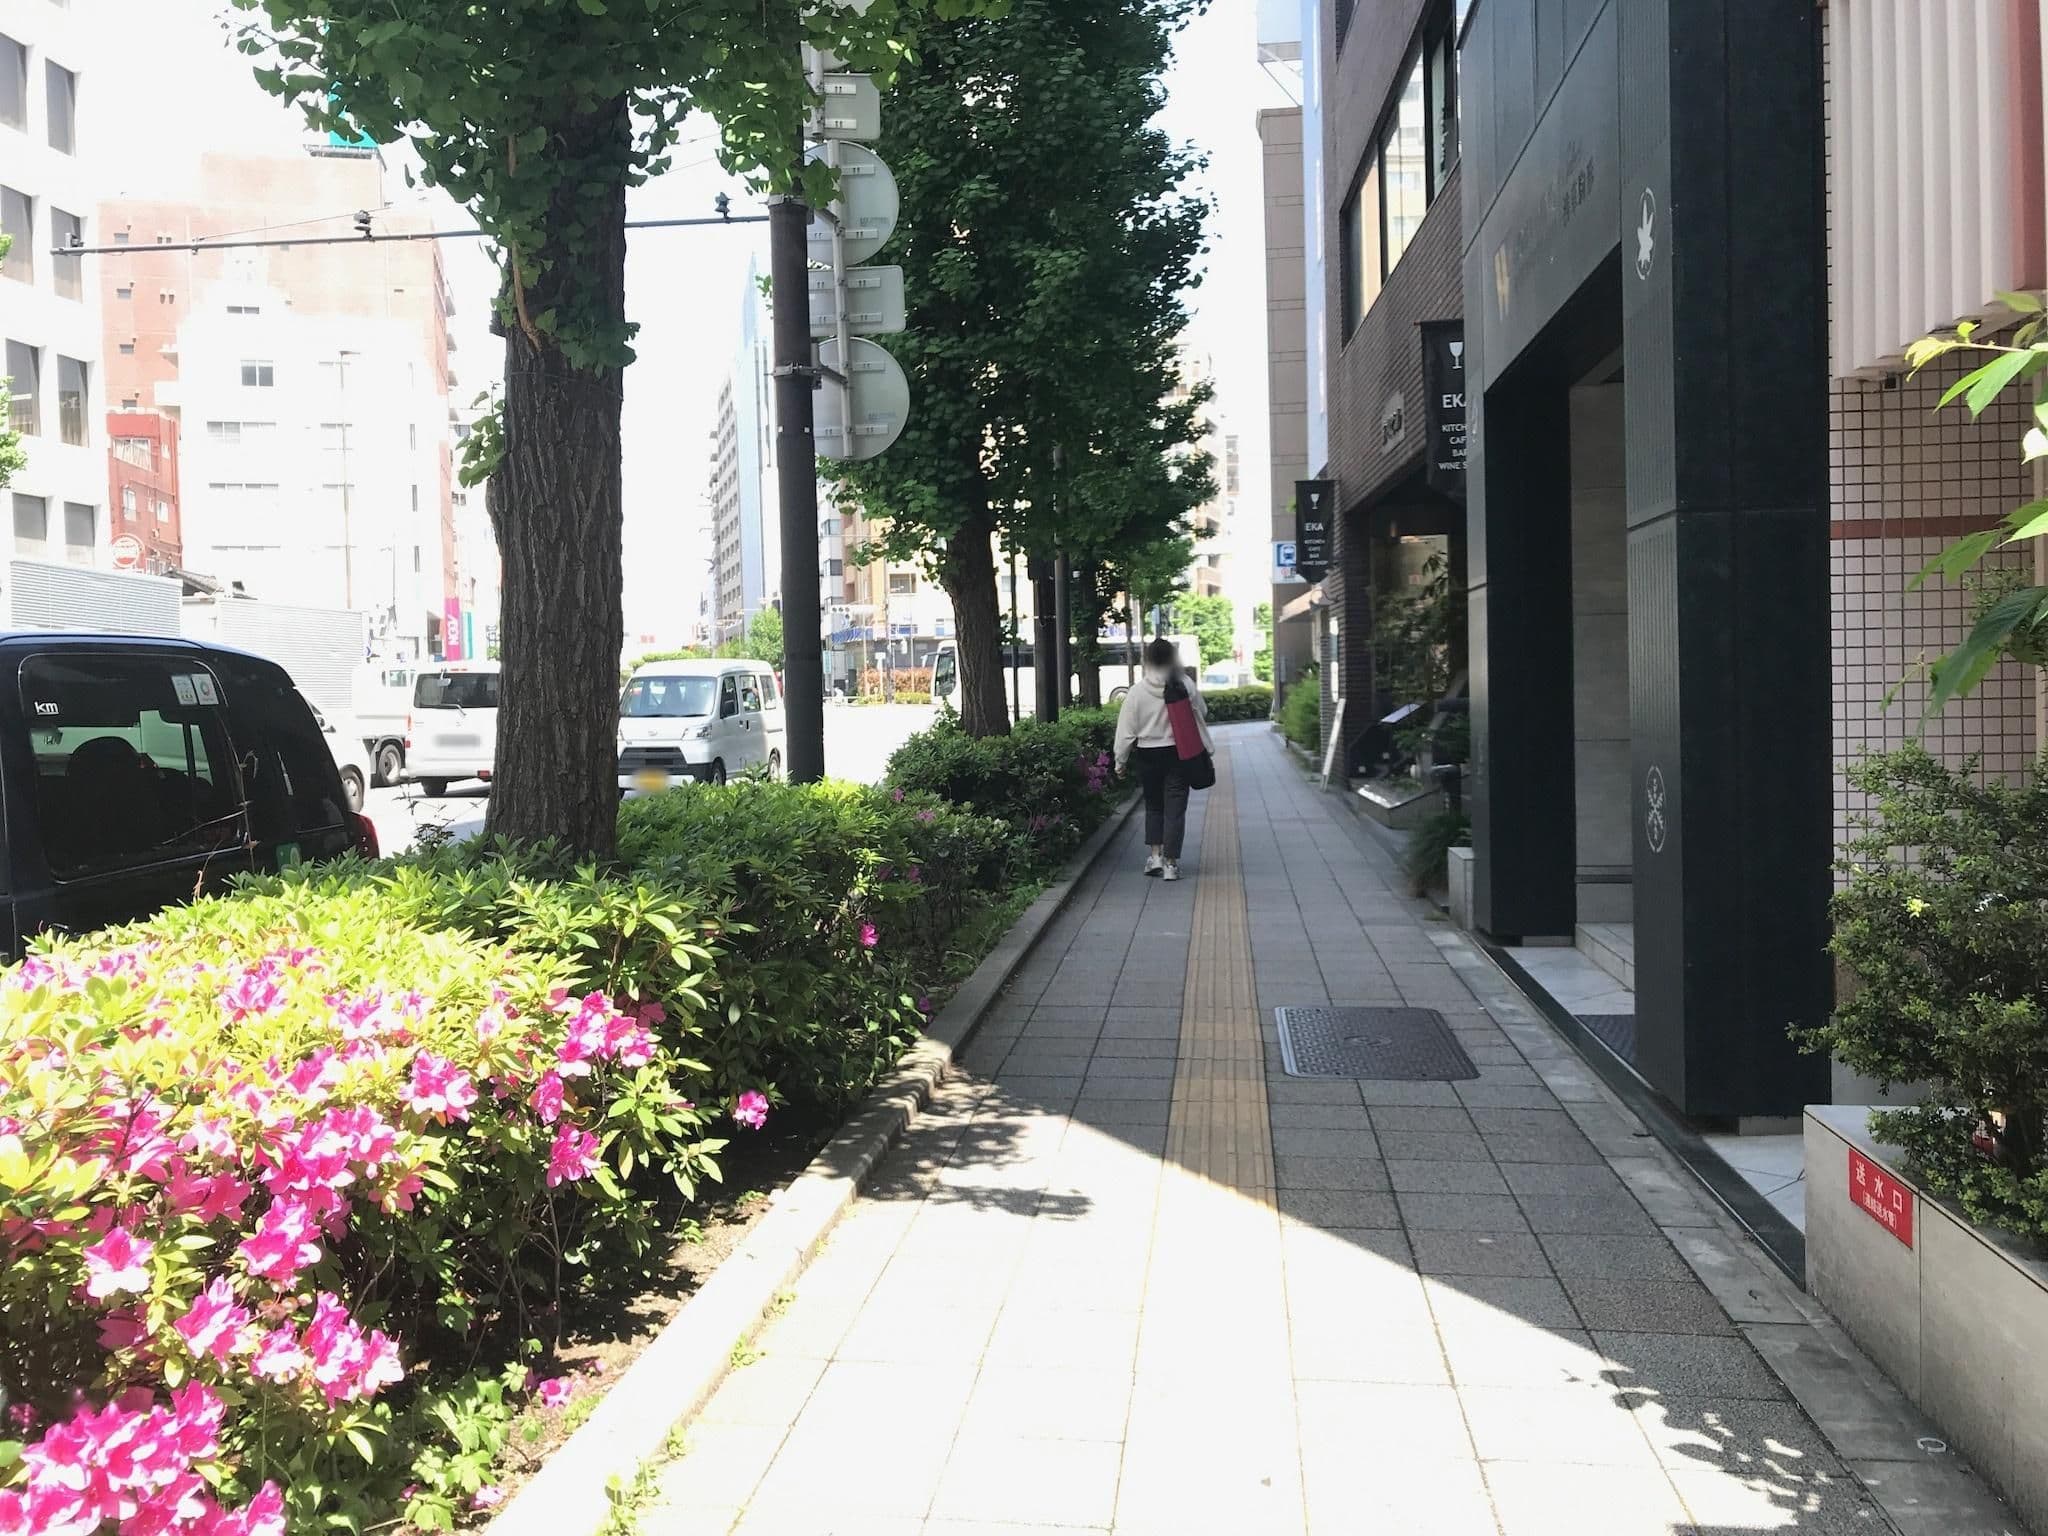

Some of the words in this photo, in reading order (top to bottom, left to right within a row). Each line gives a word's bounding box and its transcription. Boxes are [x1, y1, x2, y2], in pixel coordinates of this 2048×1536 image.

[1442, 394, 1466, 408] EK
[1305, 522, 1324, 532] EKA
[34, 701, 59, 715] km
[1856, 1161, 1903, 1213] 送水口
